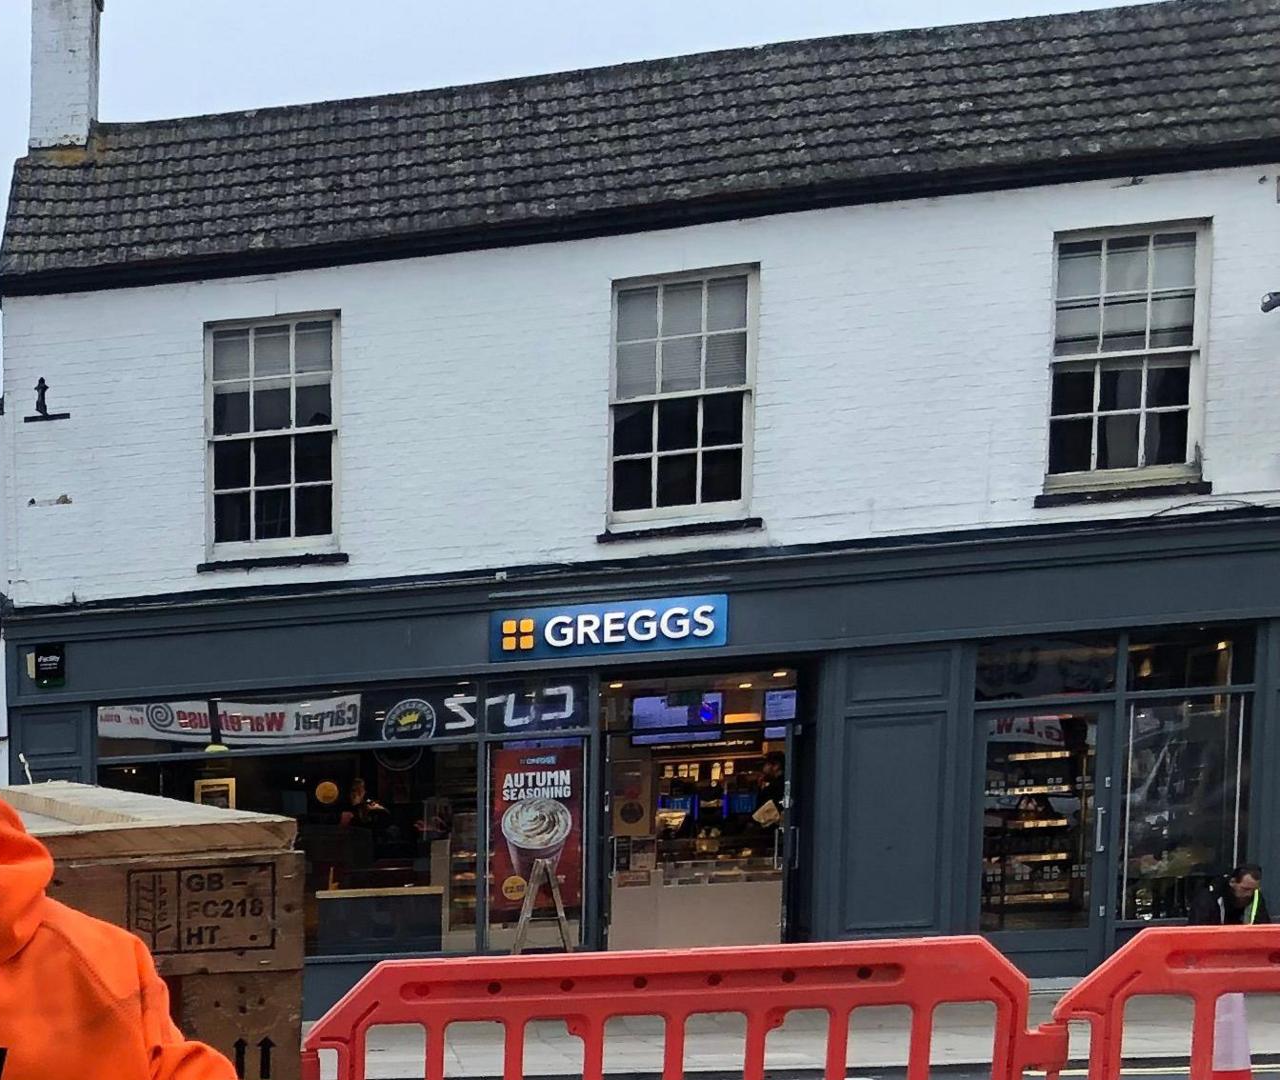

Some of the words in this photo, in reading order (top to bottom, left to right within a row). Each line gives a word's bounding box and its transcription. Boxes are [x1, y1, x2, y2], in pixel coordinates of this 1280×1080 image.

[544, 604, 716, 648] GREGGS
[502, 769, 571, 789] AUTUMN
[502, 785, 571, 801] SEASONING
[186, 873, 224, 893] GB
[186, 925, 220, 946] HT
